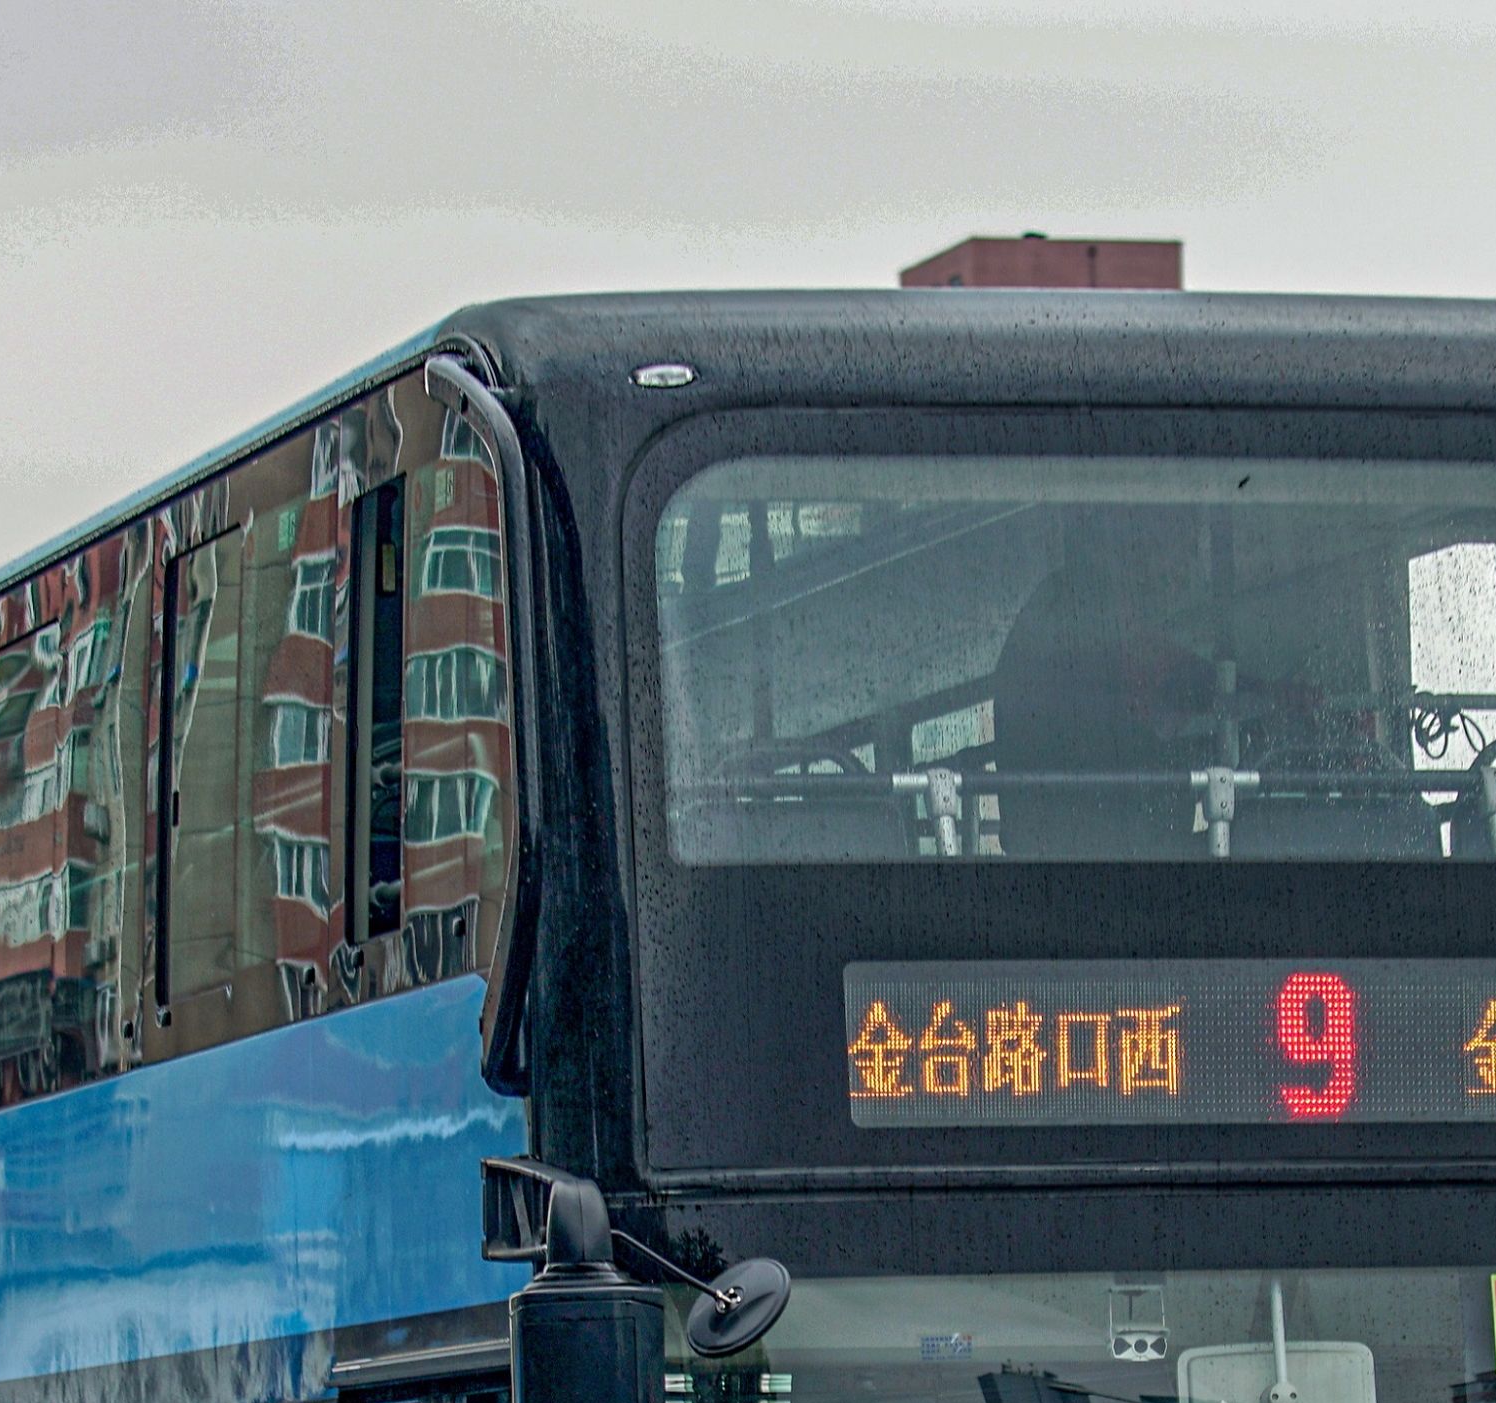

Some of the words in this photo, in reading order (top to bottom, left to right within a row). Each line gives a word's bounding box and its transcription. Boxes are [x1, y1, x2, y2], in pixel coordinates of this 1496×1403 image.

[849, 1000, 1182, 1098] 金台路口西
[1276, 971, 1356, 1117] 9
